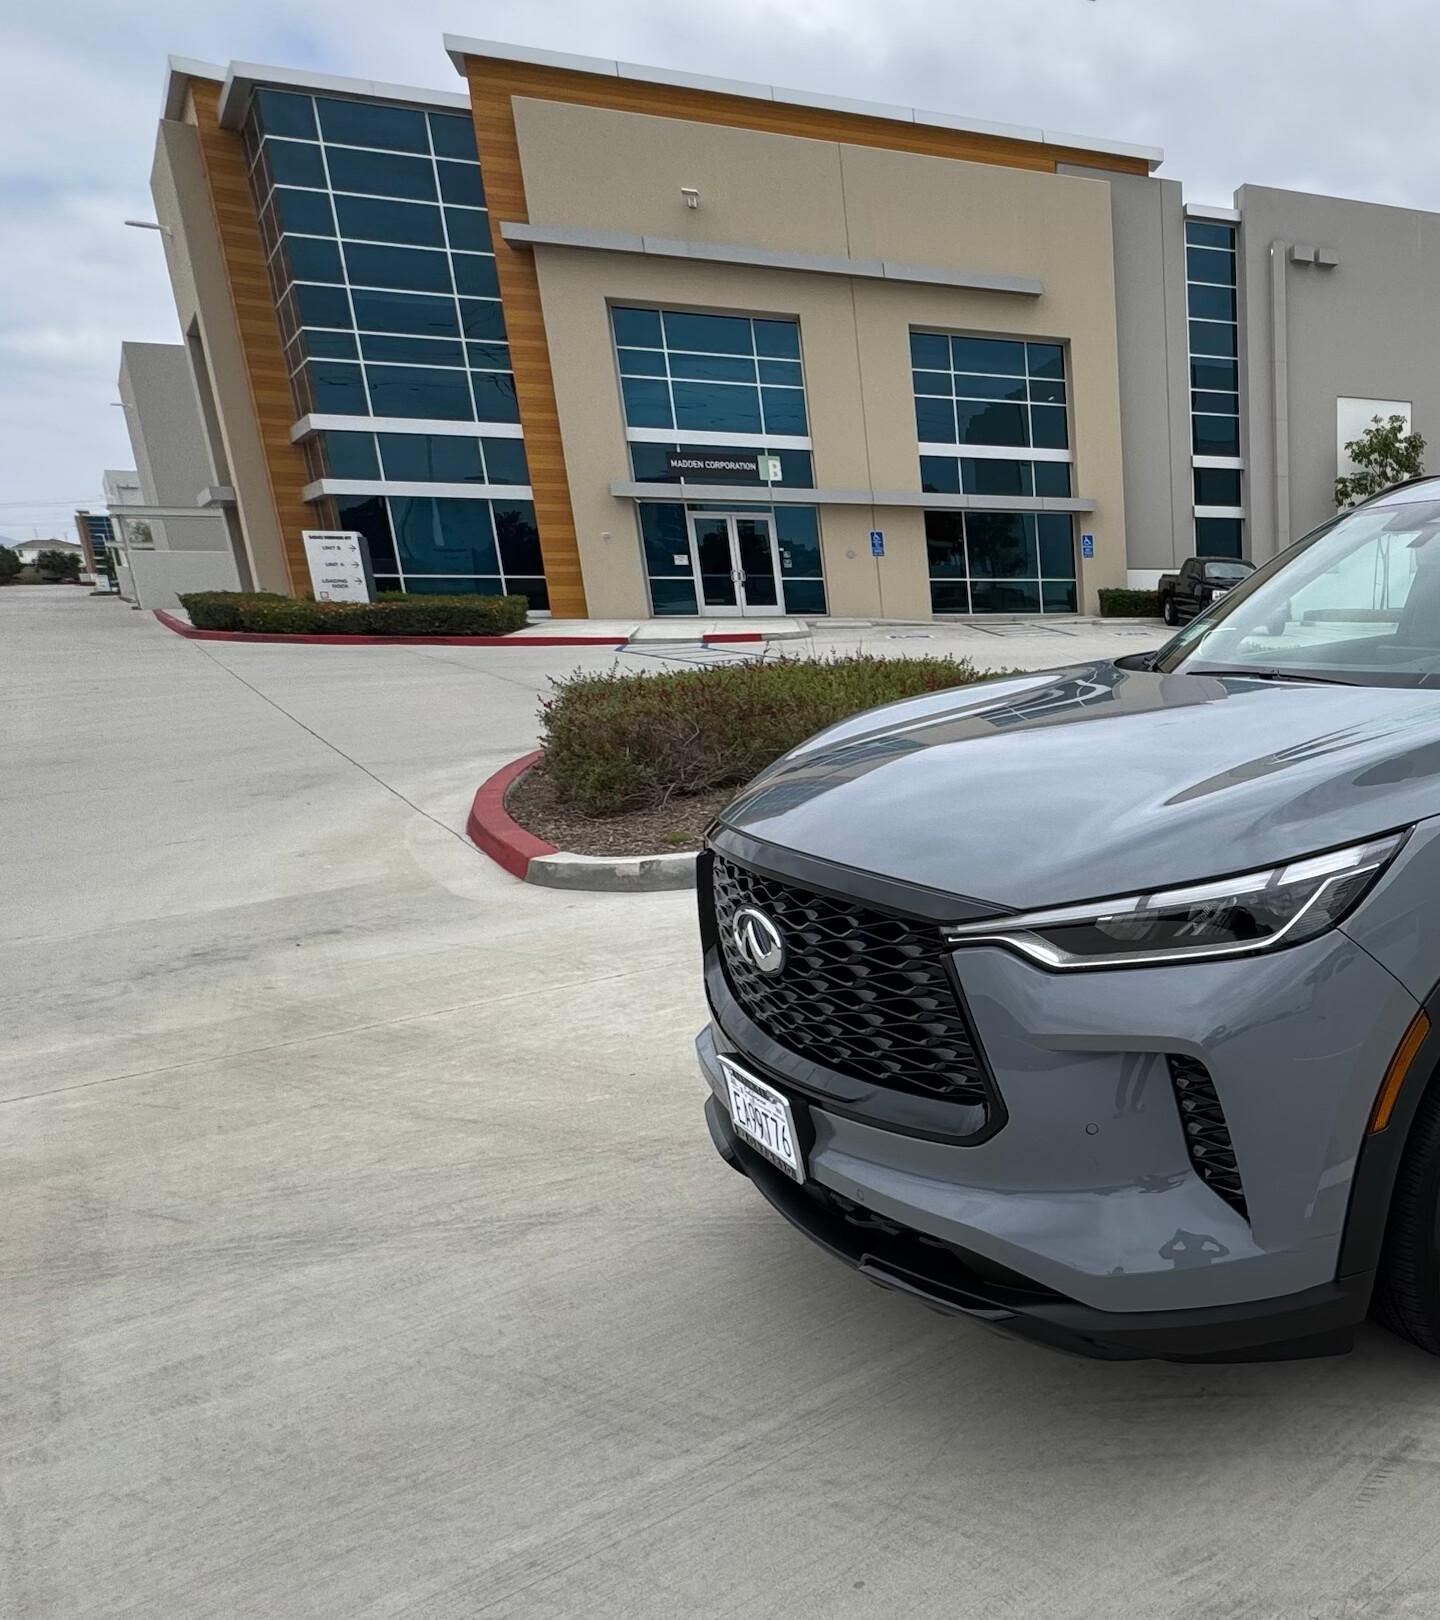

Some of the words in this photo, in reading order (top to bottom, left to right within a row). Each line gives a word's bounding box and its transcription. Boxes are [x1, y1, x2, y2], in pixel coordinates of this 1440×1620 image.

[670, 459, 703, 468] MADDEN
[705, 460, 756, 470] CORPORATION
[733, 1091, 792, 1158] EA99T76
